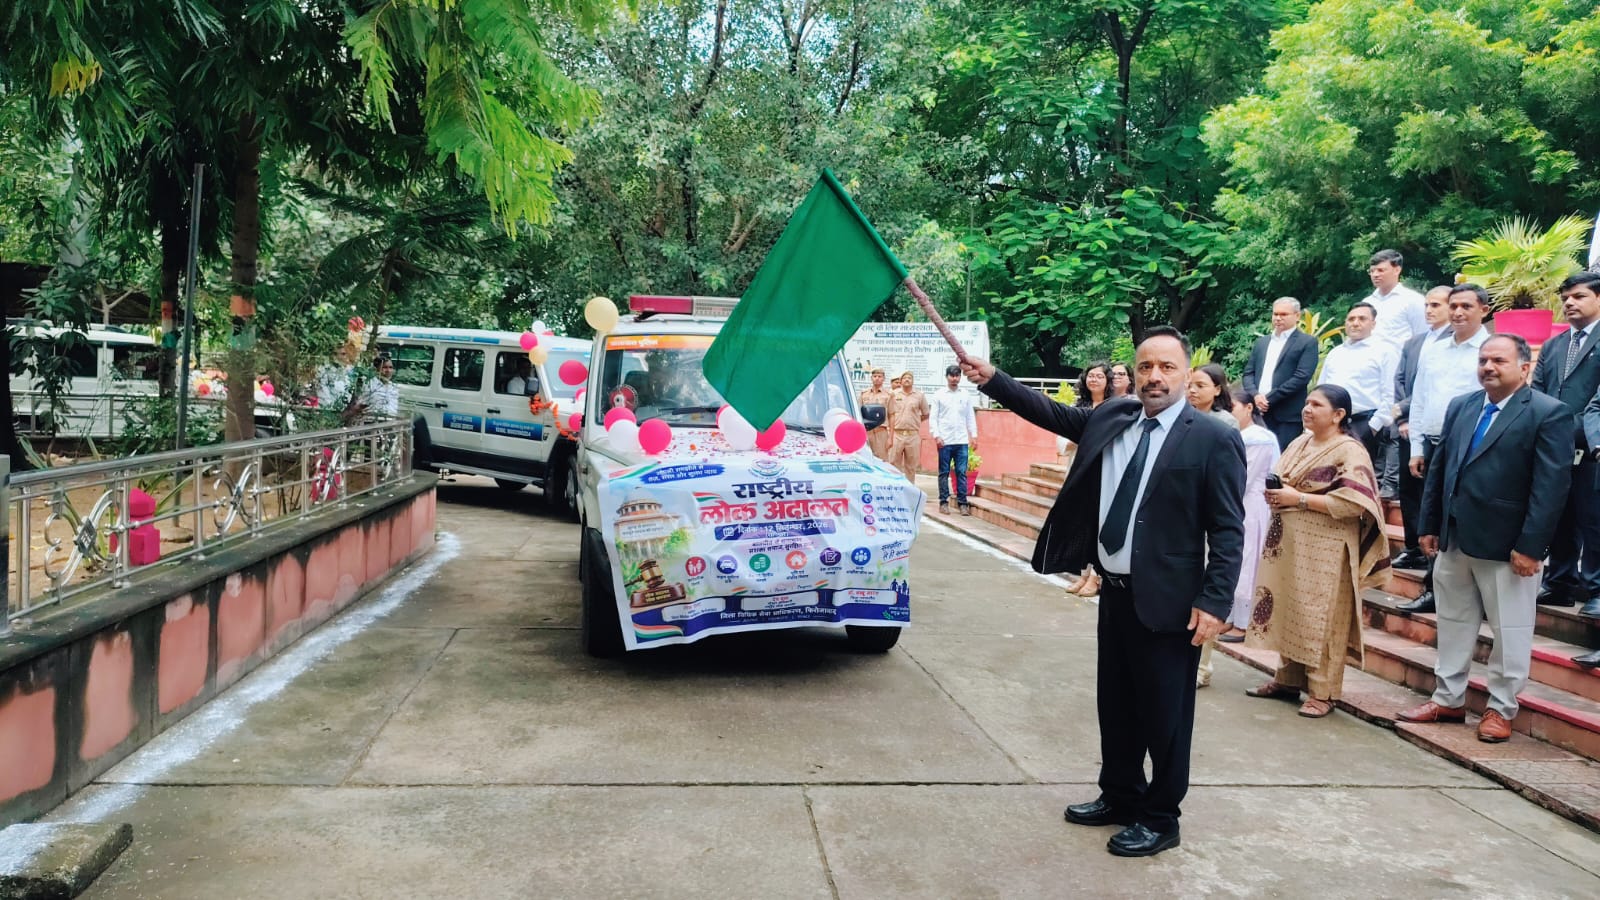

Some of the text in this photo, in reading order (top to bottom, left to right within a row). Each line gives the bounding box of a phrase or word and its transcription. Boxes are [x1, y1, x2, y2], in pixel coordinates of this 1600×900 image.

[731, 477, 815, 499] राष्ट्रीय
[699, 498, 850, 525] लोक अदालत
[765, 525, 774, 533] 12
[720, 611, 736, 619] जिला
[738, 610, 756, 618] विधिक
[759, 609, 771, 617] सेवा
